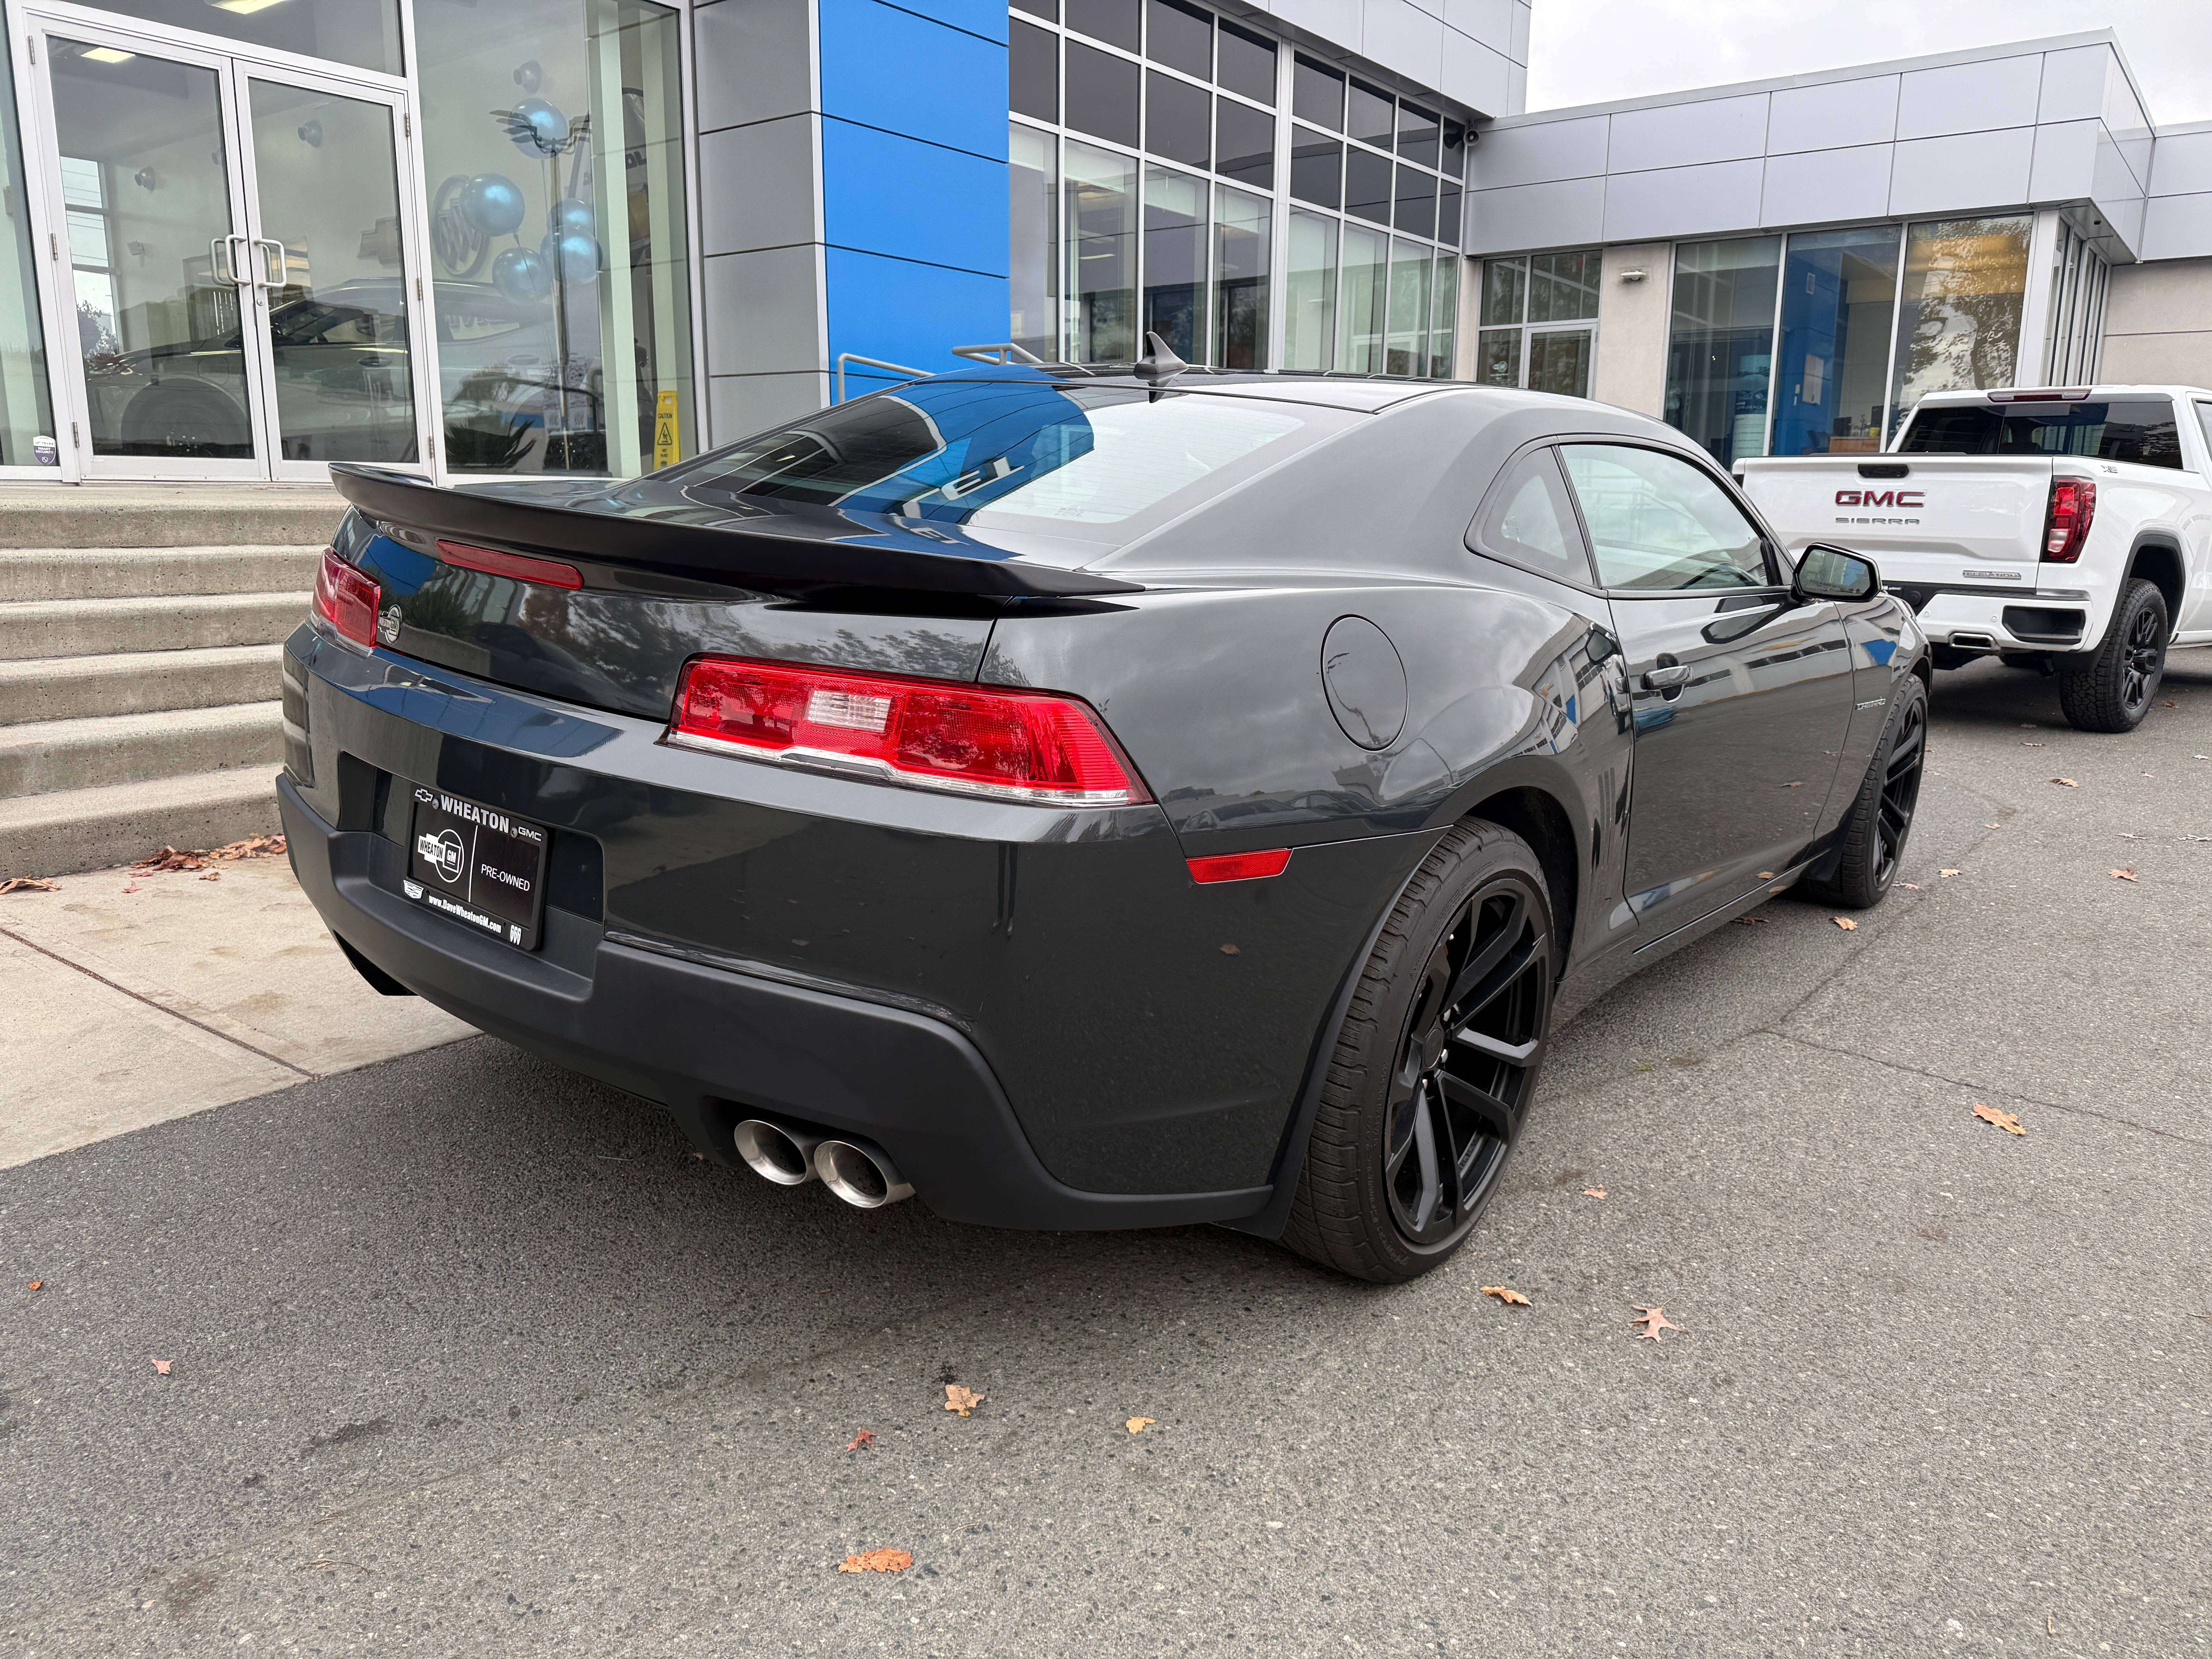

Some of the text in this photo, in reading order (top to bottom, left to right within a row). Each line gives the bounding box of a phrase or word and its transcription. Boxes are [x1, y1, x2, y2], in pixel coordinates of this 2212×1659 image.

[1834, 489, 1927, 508] GMC
[1834, 517, 1920, 525] SIERRA
[1855, 699, 1886, 710] CAMARO
[440, 794, 543, 842] WHEATON GMC
[420, 838, 457, 864] WHEATON GM
[481, 863, 530, 891] PRE-OWNED
[429, 895, 502, 934] www.DaveWheatonGM.com
